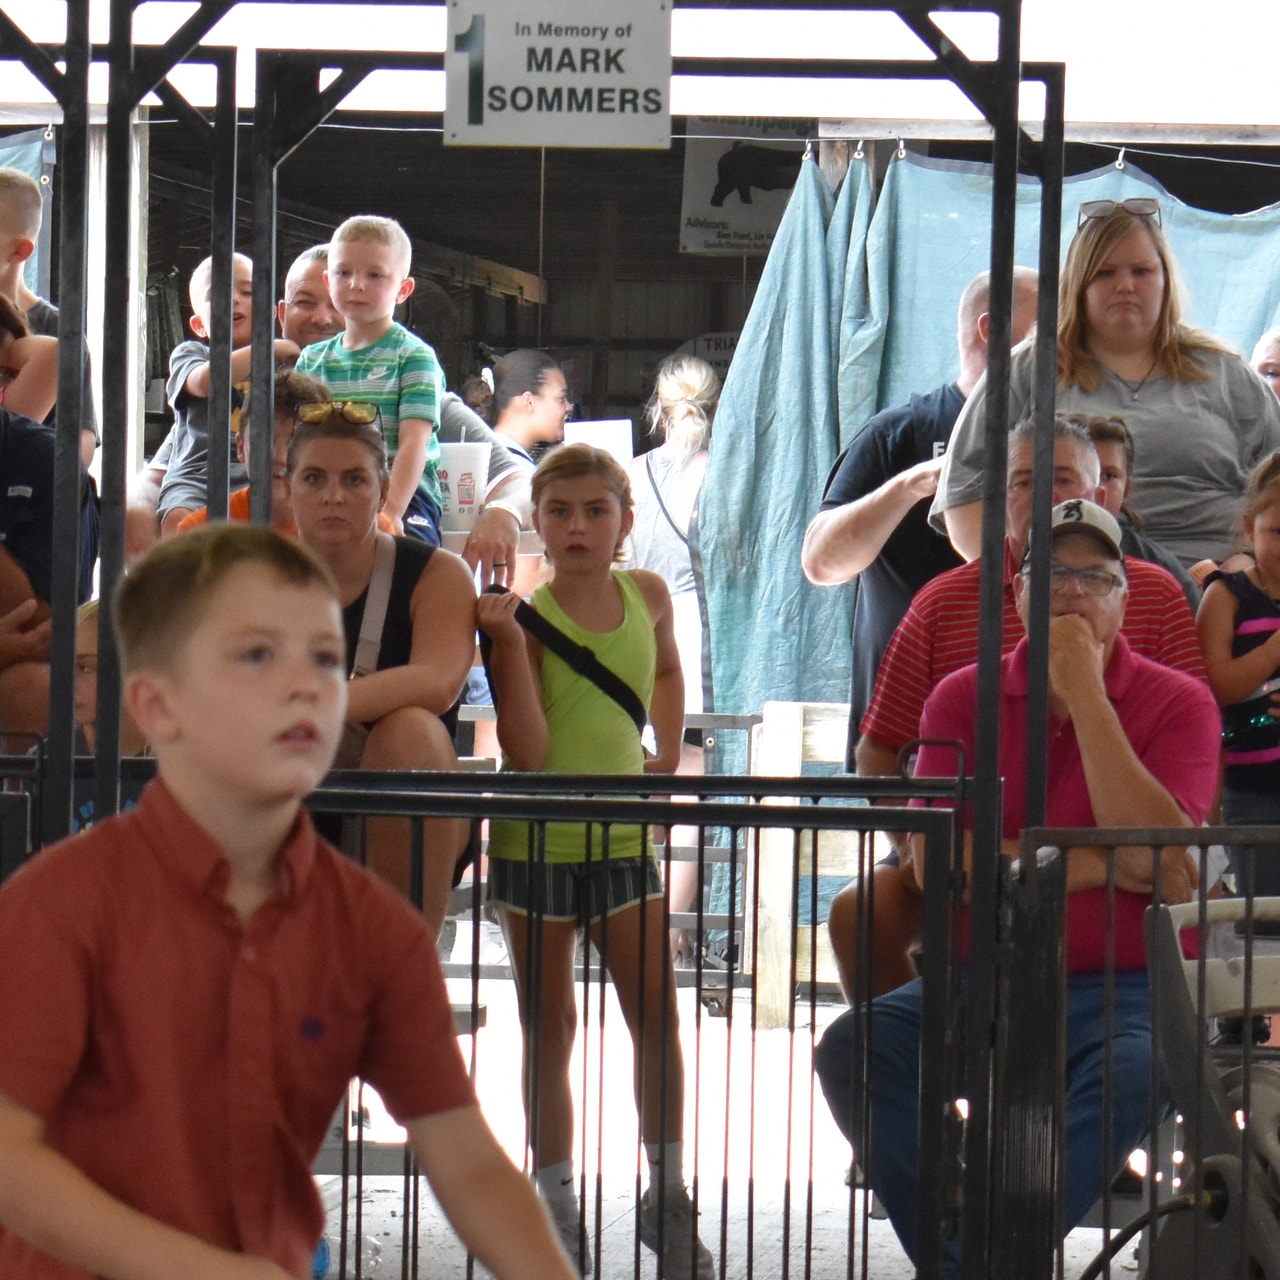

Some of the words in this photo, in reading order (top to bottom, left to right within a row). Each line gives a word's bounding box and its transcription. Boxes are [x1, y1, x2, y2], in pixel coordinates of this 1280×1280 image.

[515, 22, 531, 37] In
[538, 22, 608, 41] Memory
[614, 23, 632, 38] of
[455, 14, 485, 126] 1
[526, 47, 625, 74] MARK
[487, 86, 662, 114] SOMMERS
